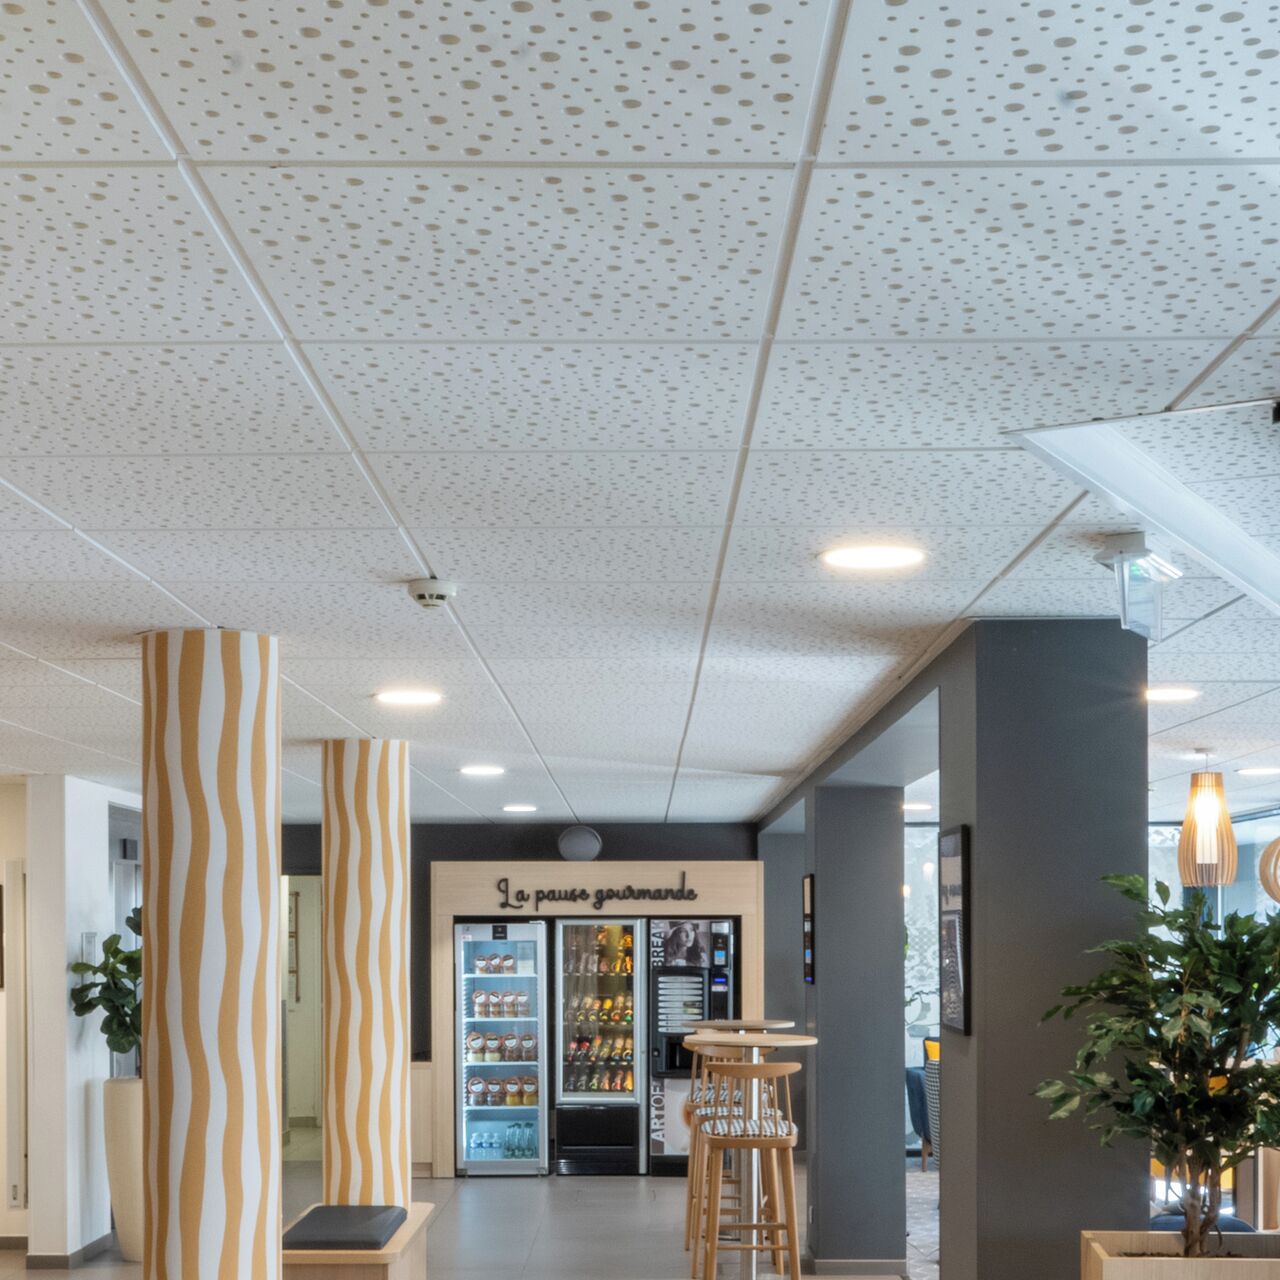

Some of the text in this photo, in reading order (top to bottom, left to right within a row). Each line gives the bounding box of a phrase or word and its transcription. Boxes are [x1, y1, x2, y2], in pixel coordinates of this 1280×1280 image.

[496, 870, 699, 912] La pause gourmande
[651, 920, 665, 968] BREAK
